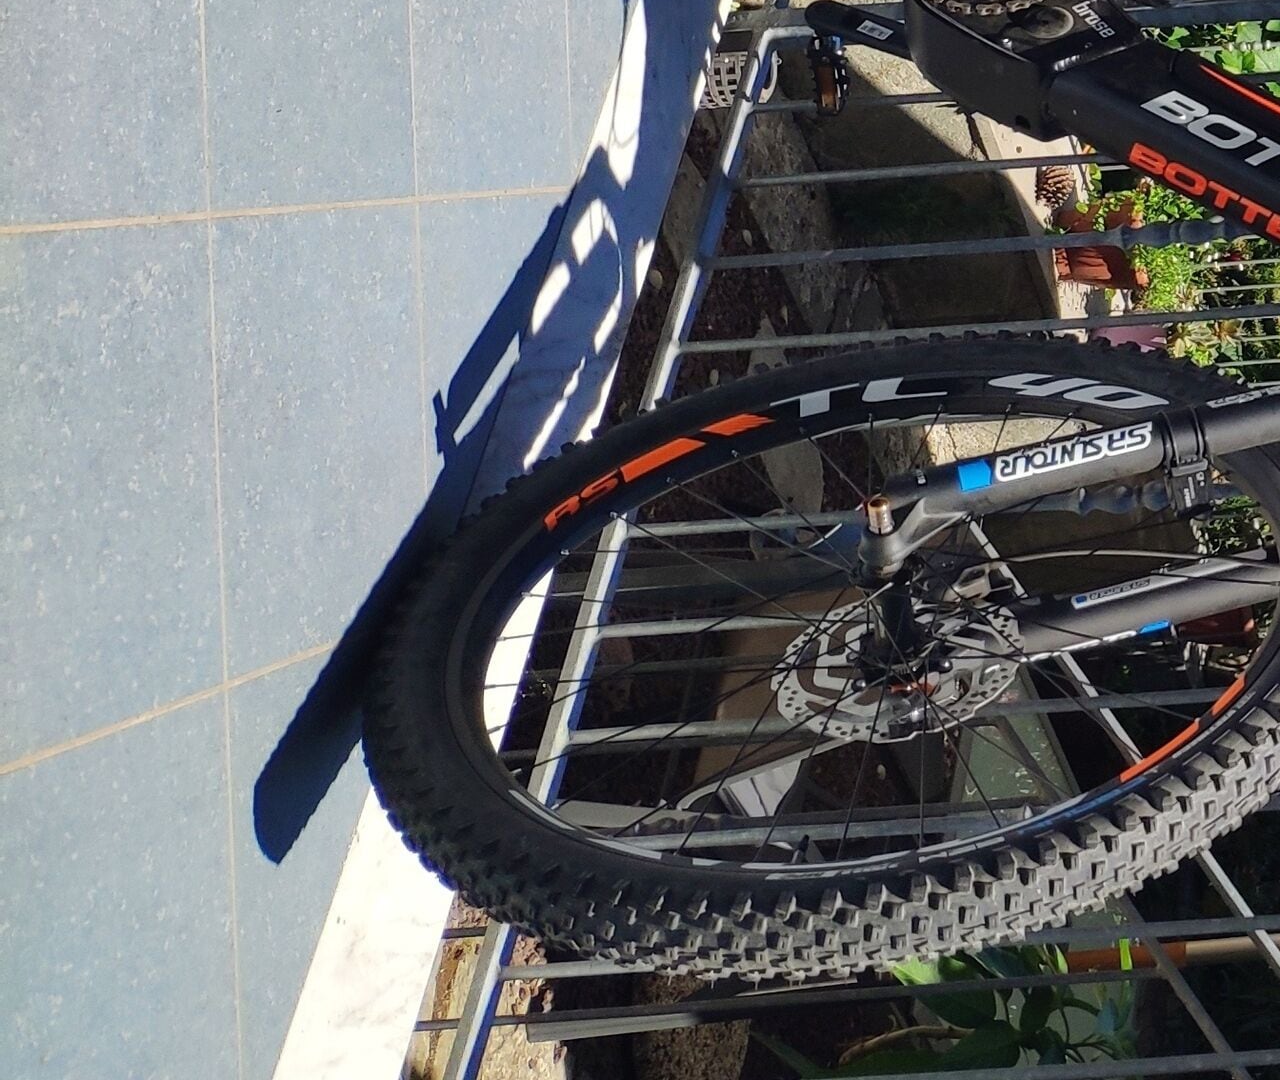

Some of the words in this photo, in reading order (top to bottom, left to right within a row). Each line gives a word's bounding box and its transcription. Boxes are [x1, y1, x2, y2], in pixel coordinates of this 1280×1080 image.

[1072, 0, 1116, 38] brose
[988, 373, 1171, 409] 40
[1000, 435, 1104, 478] SUNTOUR
[1107, 424, 1150, 453] SR
